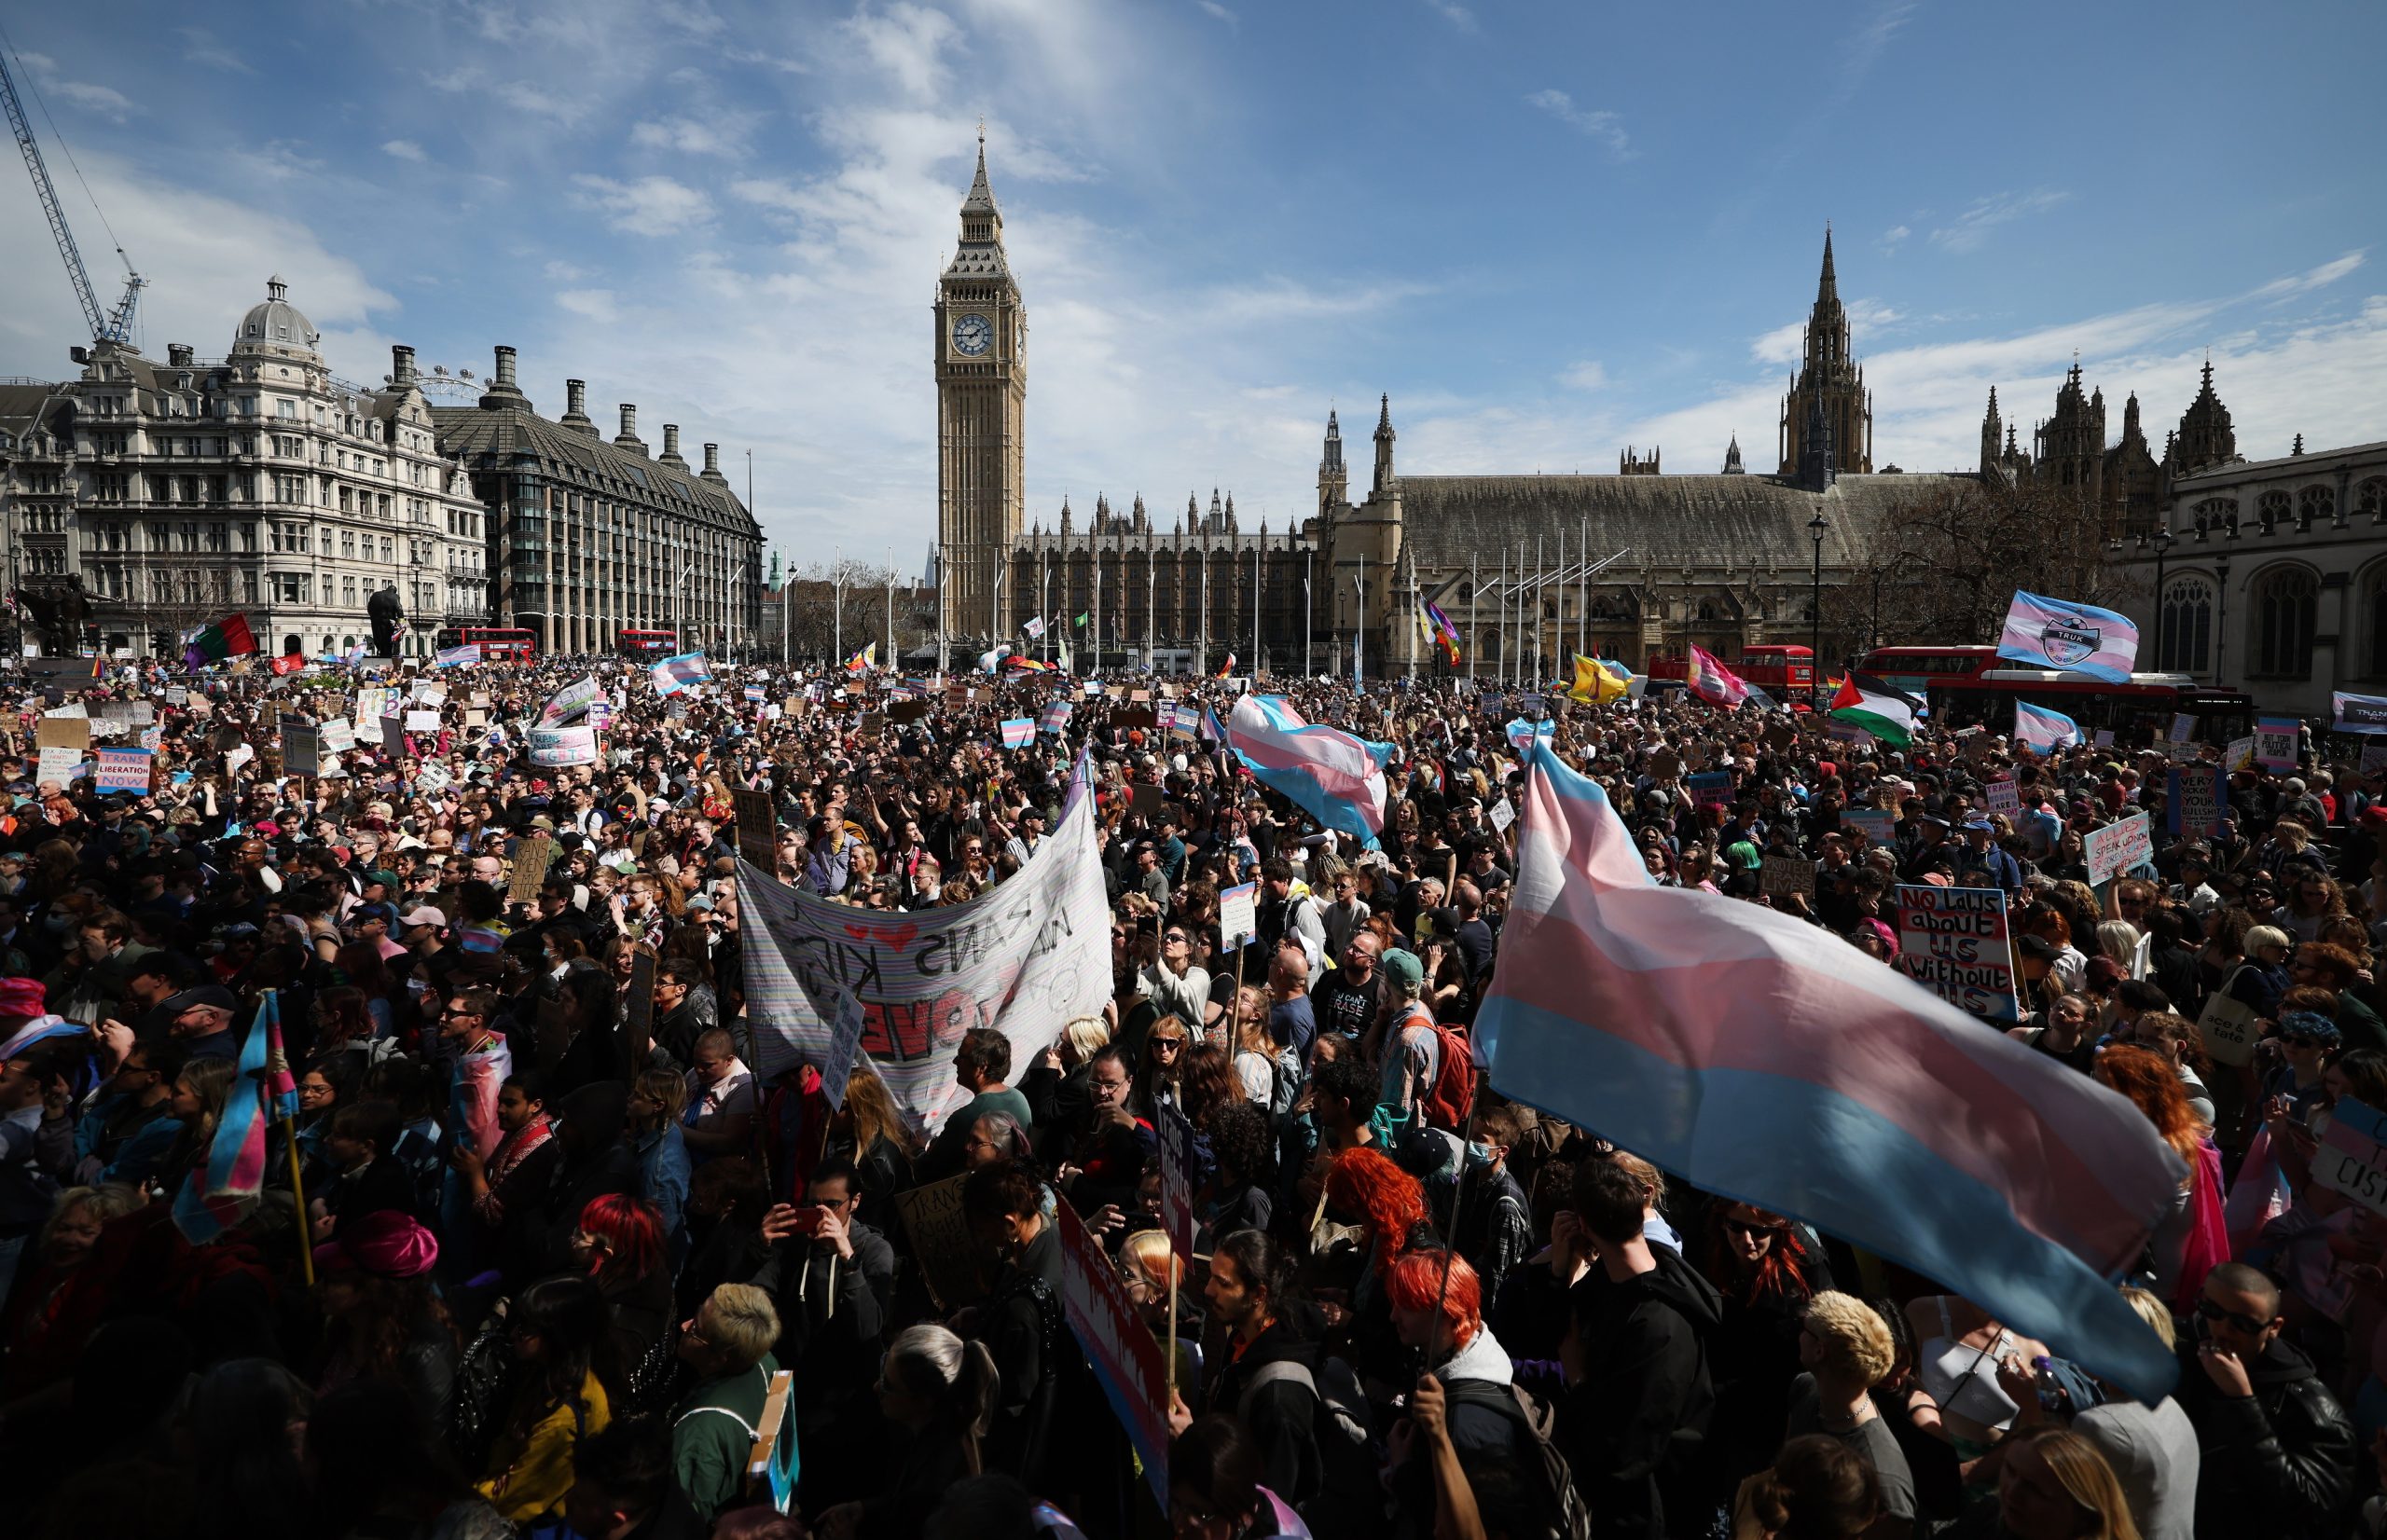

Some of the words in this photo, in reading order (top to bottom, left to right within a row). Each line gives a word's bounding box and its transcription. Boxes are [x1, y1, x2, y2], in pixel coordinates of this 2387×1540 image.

[2058, 631, 2084, 642] TRUK
[589, 712, 608, 721] Rights
[1158, 709, 1175, 718] Rights
[529, 734, 560, 743] TRANS
[2262, 740, 2291, 750] POLITICAL
[104, 754, 144, 763] TRANS
[531, 749, 586, 762] RIGHTS
[2267, 749, 2287, 757] WEAPON
[100, 765, 148, 774] LIBERATION
[103, 777, 144, 786] NOW
[418, 777, 435, 791] RIGHTS
[422, 773, 440, 785] HUMAN
[2179, 776, 2214, 785] VERY
[1986, 782, 2015, 792] TRANS
[1989, 792, 2017, 802] WOMEN
[2182, 796, 2215, 807] YOUR
[1995, 802, 2010, 810] ARE
[2182, 806, 2221, 816] BULLSHIT
[2096, 819, 2140, 845] ALLIES
[517, 840, 548, 859] RANS
[2094, 842, 2121, 859] SPEAK
[2123, 836, 2133, 848] UP
[2133, 832, 2147, 845] NOW
[514, 858, 545, 873] OMEN
[2091, 860, 2103, 873] OR
[2104, 852, 2130, 866] FOREVER
[522, 873, 536, 884] MY
[510, 883, 541, 901] STERS
[1900, 887, 1936, 911] NO
[1911, 911, 1994, 936] about
[1329, 997, 1364, 1017] ERASE
[1345, 994, 1367, 1007] CAN'T
[2207, 1014, 2232, 1029] ace
[2236, 1024, 2245, 1034] &
[2215, 1027, 2244, 1043] tate
[1155, 1100, 1183, 1159] Trans
[1160, 1137, 1190, 1209] Rights
[904, 1179, 965, 1220] TRANS
[1162, 1176, 1179, 1237] Now
[916, 1206, 964, 1242] RIGHT
[1092, 1243, 1133, 1327] Labour
